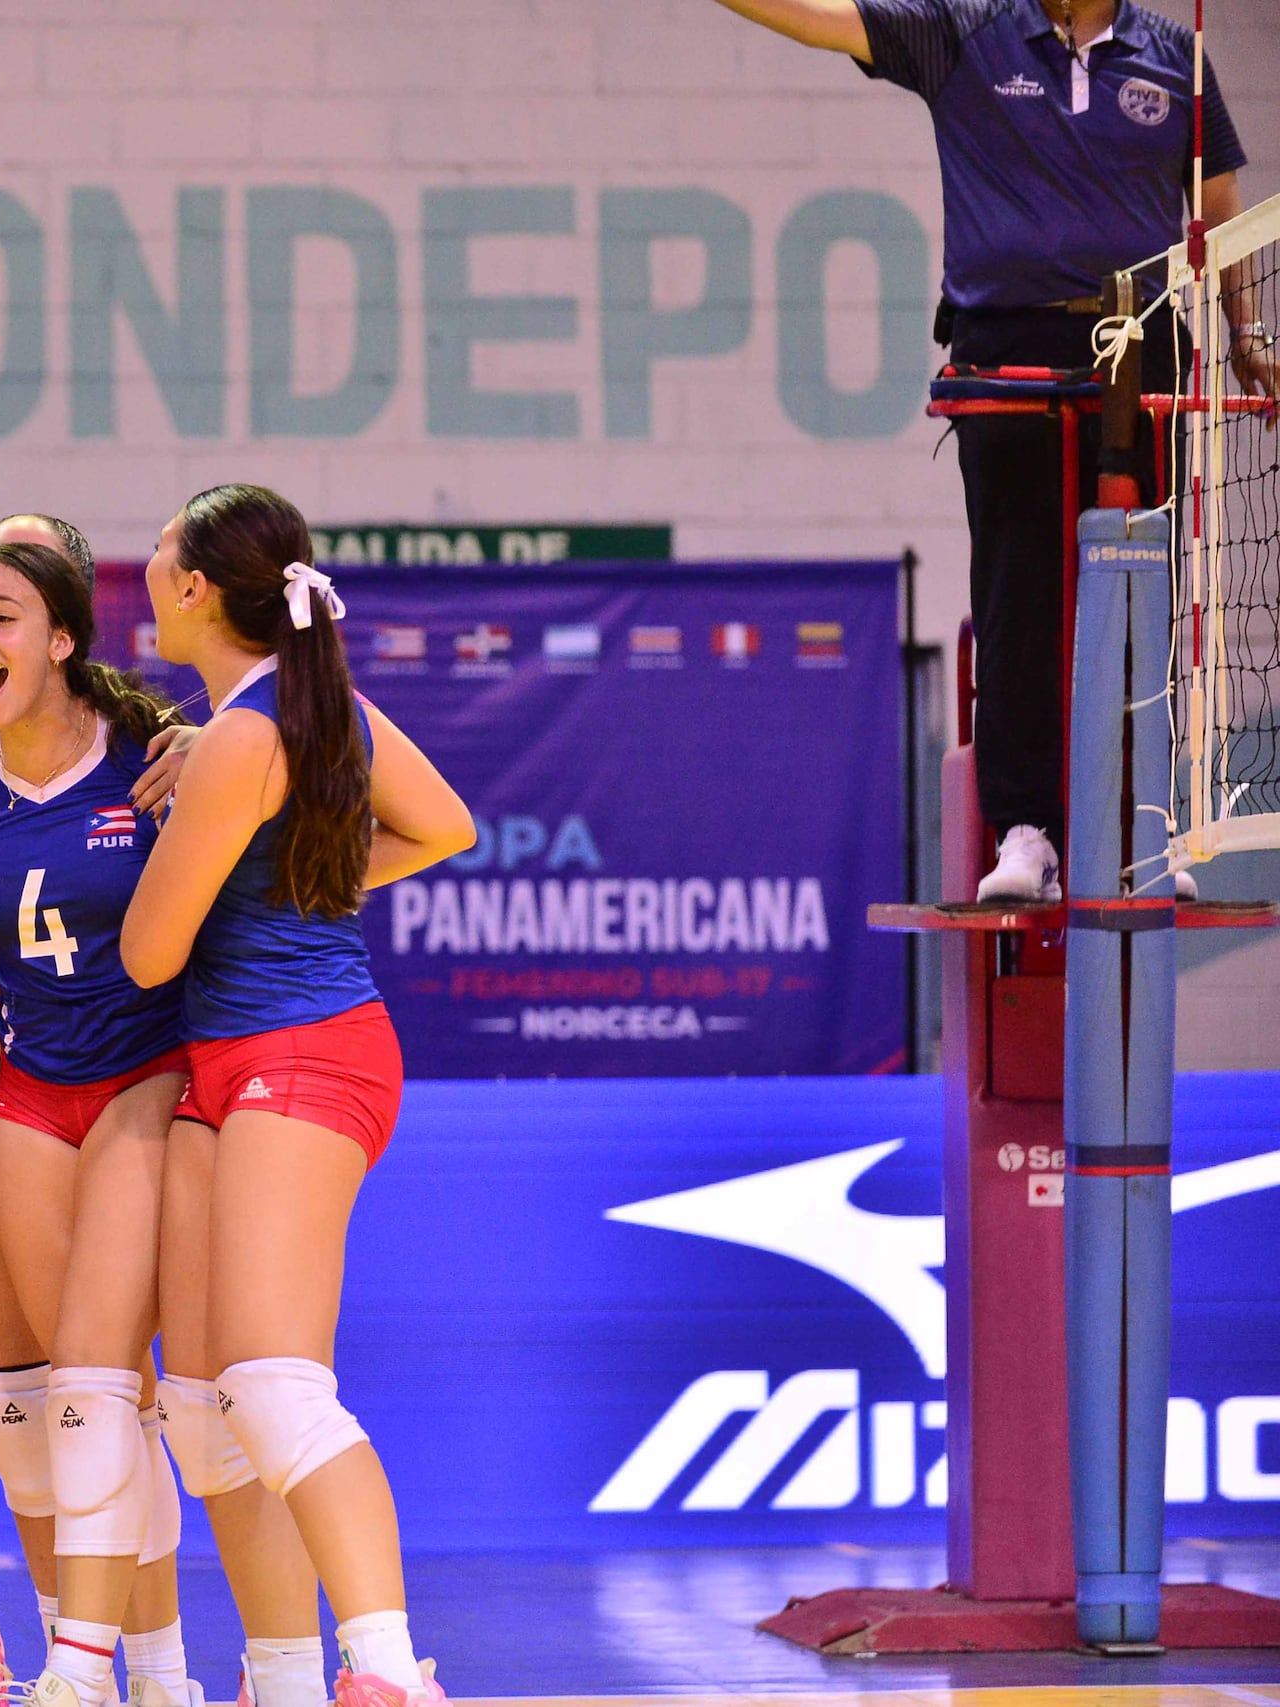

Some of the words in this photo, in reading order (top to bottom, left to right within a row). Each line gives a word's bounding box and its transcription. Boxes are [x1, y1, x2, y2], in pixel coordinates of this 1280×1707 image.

[86, 835, 134, 850] PUR
[446, 814, 603, 872] OPA
[18, 868, 79, 977] 4
[391, 876, 831, 954] PANAMERICANA
[521, 1003, 703, 1042] NORCECA
[1, 1412, 28, 1425] PEAK
[60, 1416, 86, 1429] PEAK
